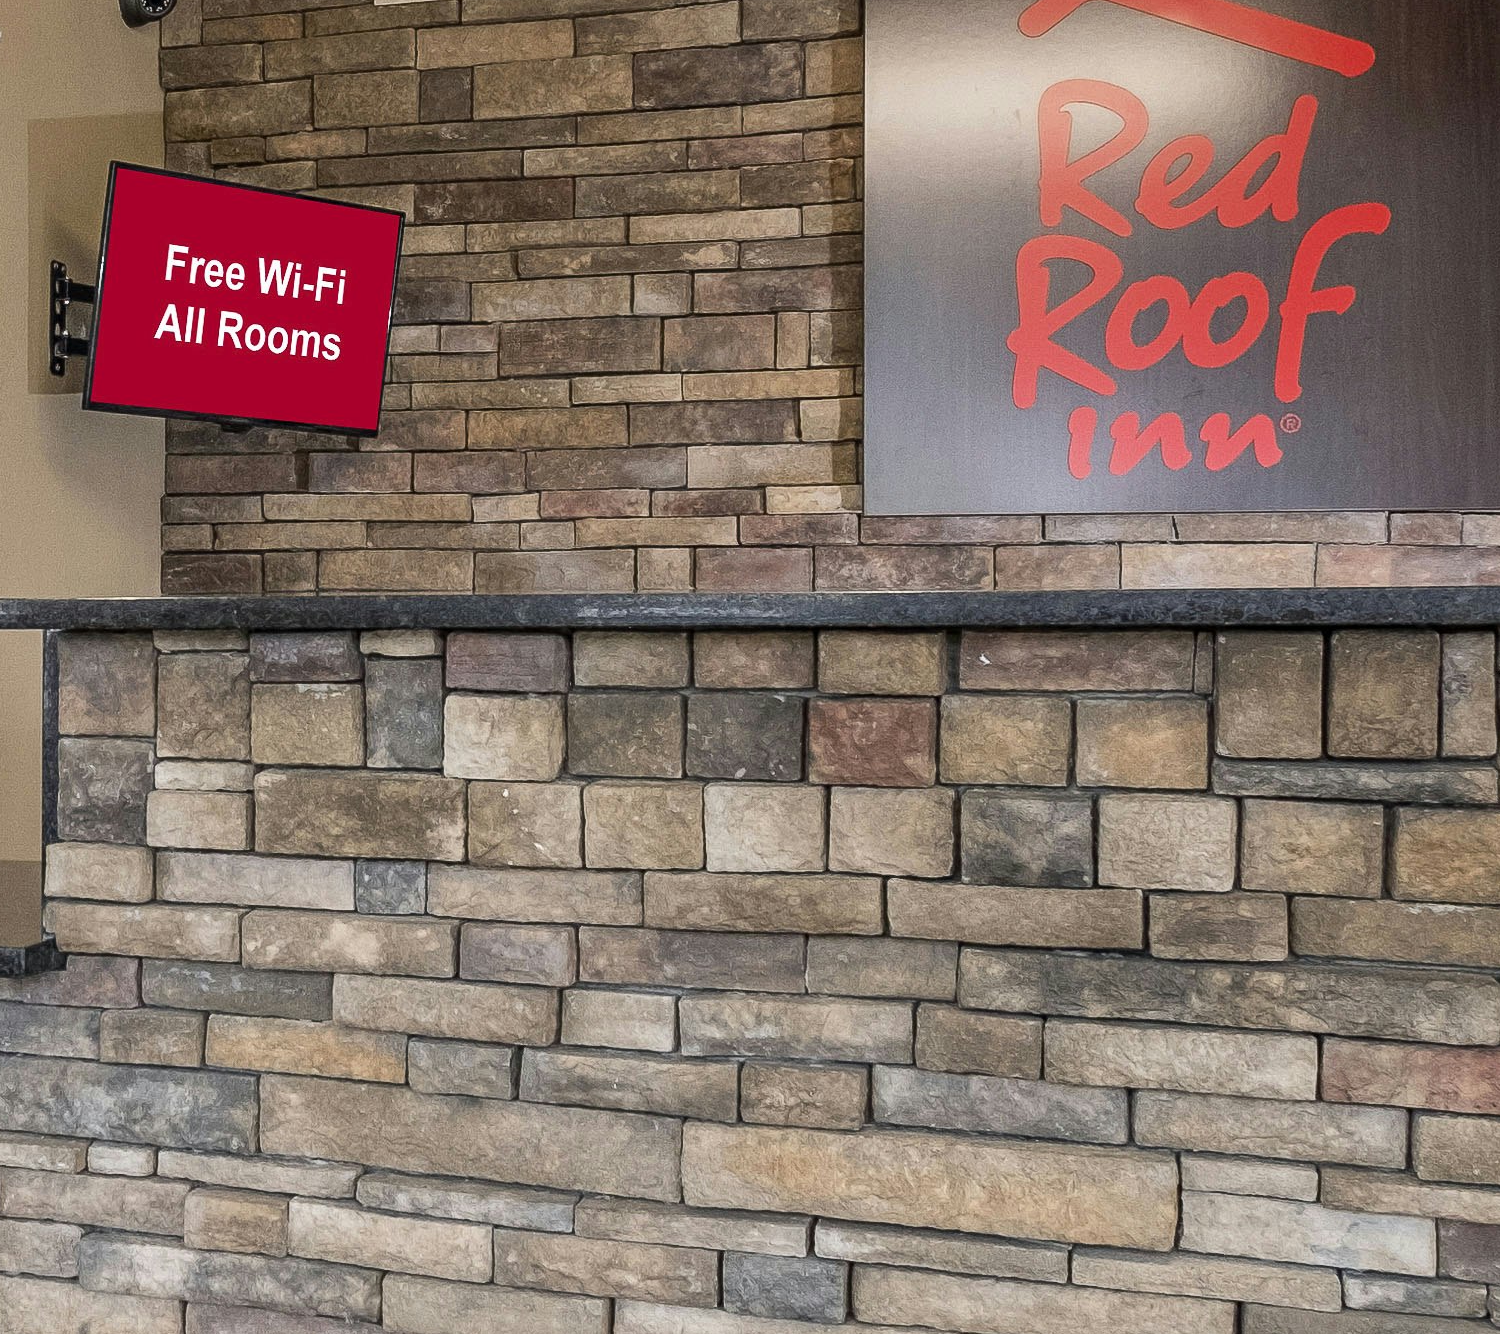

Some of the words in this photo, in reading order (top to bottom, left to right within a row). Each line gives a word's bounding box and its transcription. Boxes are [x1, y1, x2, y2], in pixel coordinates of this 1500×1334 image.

[1039, 79, 1318, 237] Red
[165, 244, 246, 291] Free
[258, 258, 347, 305] Wi-Fi
[1006, 202, 1391, 409] Roof
[154, 303, 206, 345] All
[217, 310, 342, 361] Rooms
